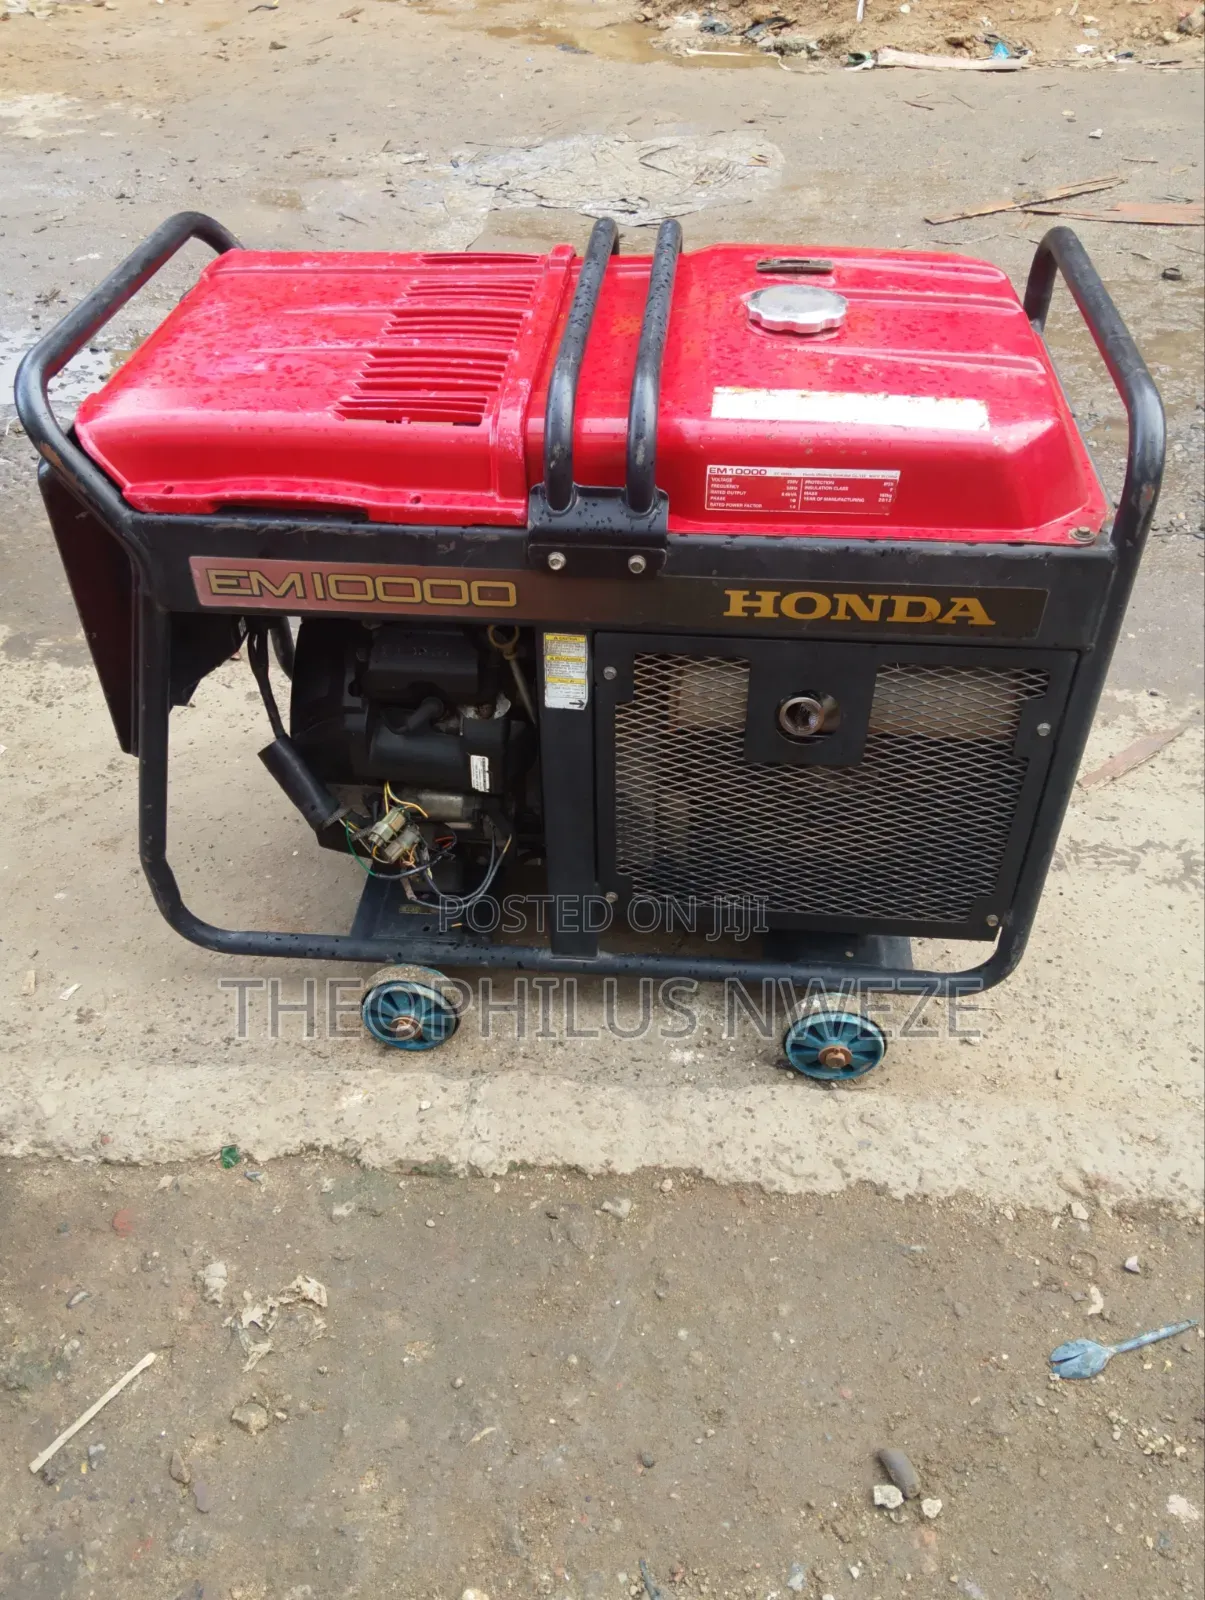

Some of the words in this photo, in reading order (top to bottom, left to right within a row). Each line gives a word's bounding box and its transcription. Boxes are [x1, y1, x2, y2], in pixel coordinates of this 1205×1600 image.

[709, 467, 767, 475] EM10000
[206, 568, 517, 607] EM10000
[723, 589, 996, 626] HONDA
